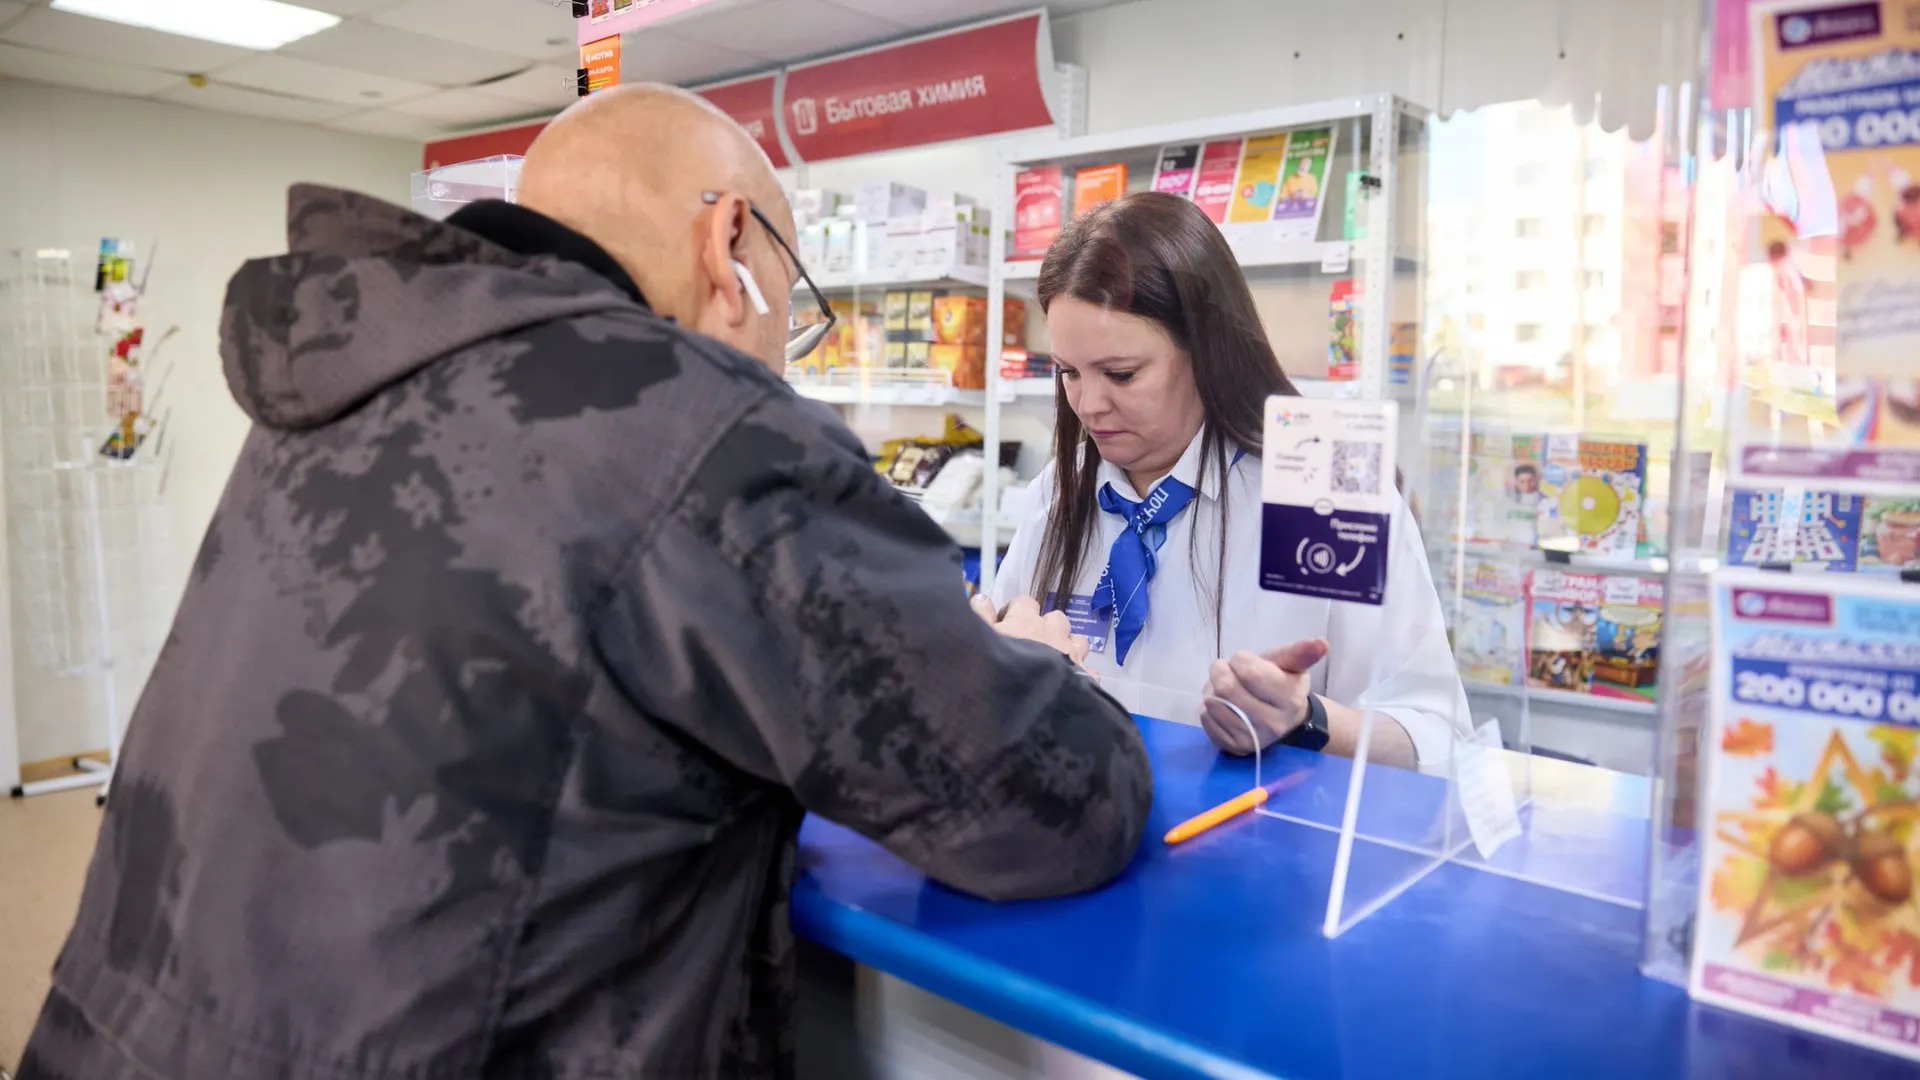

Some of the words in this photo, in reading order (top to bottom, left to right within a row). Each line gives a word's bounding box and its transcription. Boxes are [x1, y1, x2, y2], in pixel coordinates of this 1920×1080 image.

[825, 89, 913, 124] Бытовая
[916, 74, 987, 108] химия
[1735, 670, 1805, 707] 200
[1808, 680, 1884, 718] 000
[1887, 690, 1920, 724] 0
